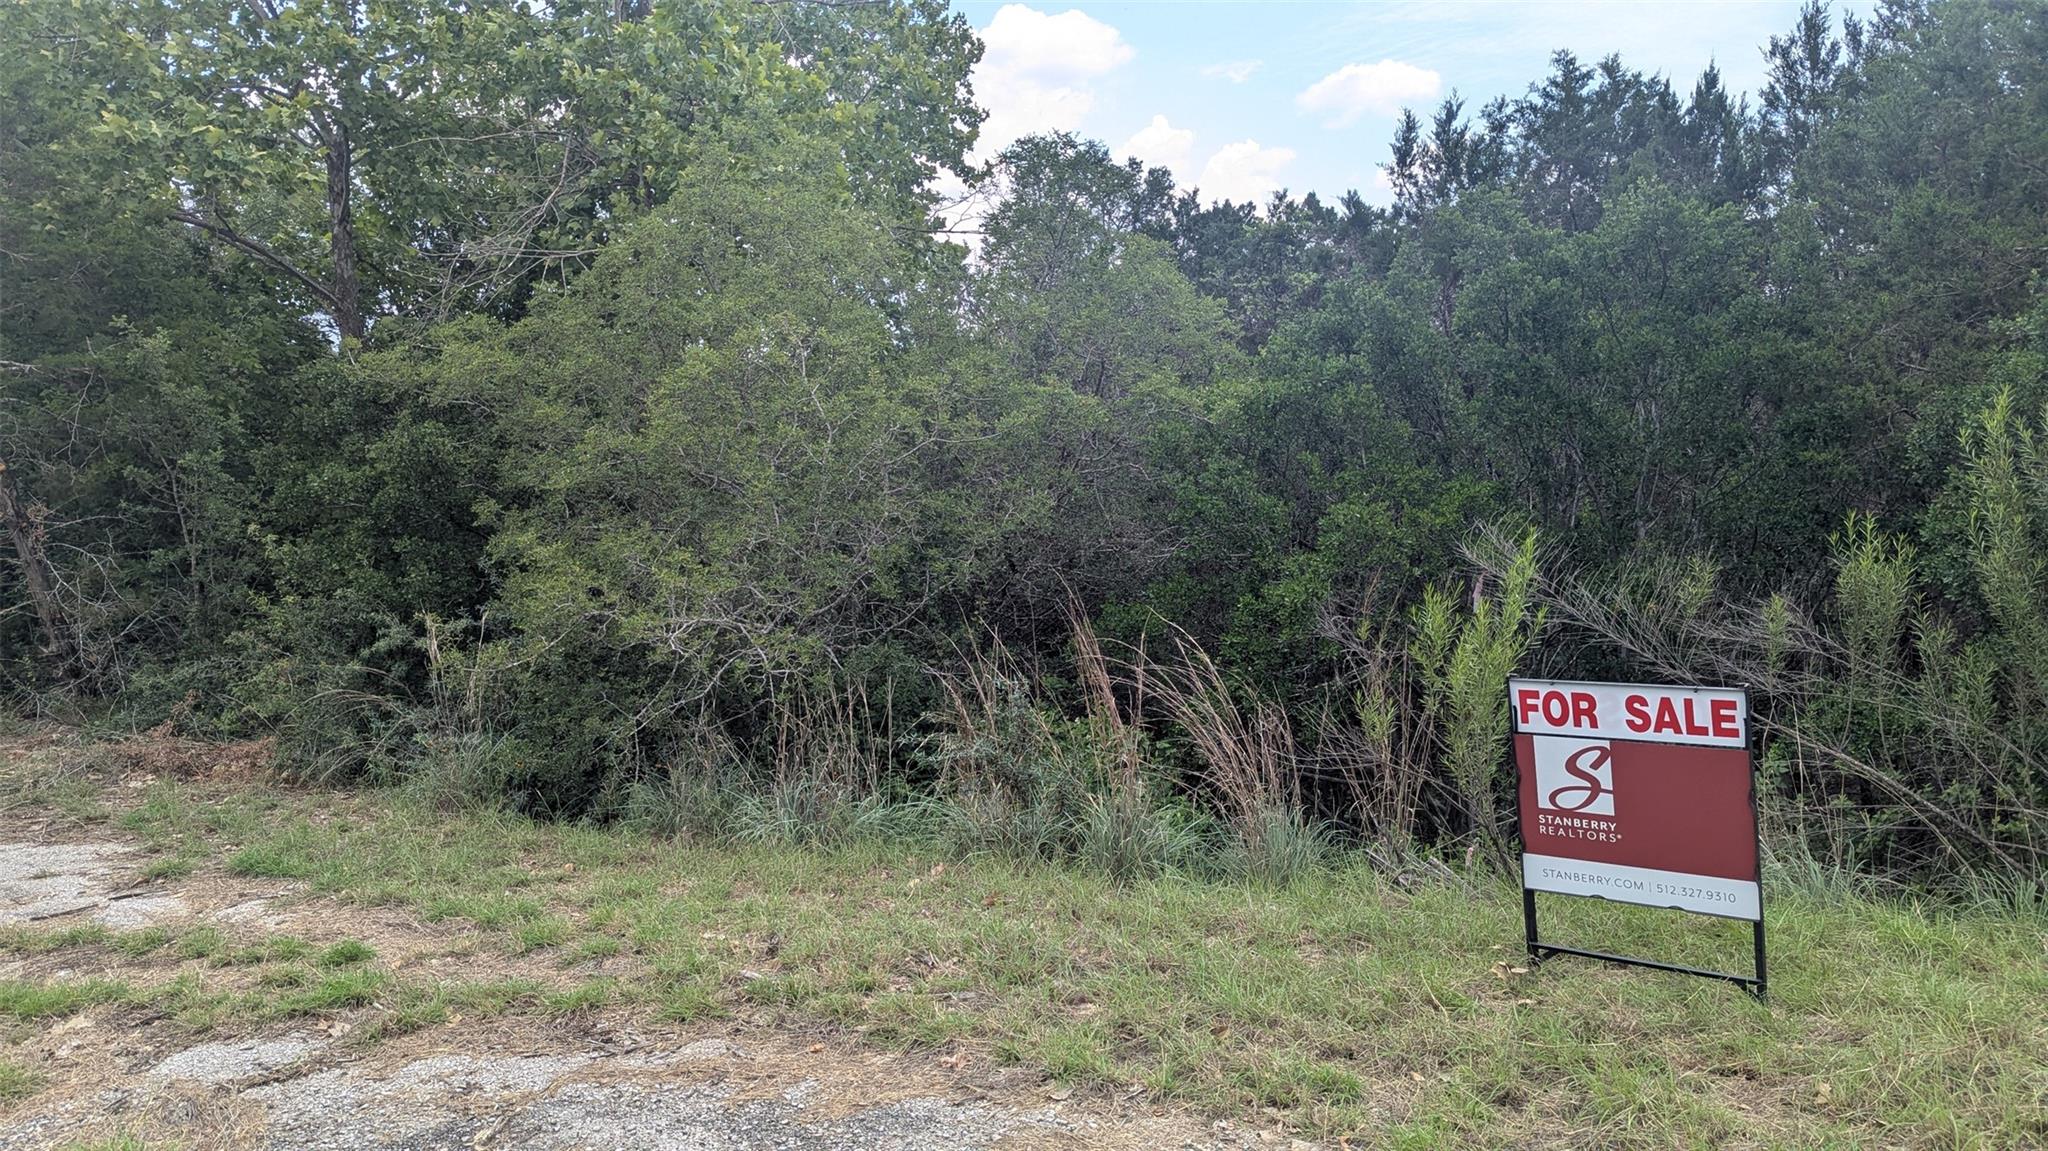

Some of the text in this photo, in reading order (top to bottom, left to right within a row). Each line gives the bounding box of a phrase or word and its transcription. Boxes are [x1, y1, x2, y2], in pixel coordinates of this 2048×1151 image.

[1518, 689, 1740, 738] FOR SALE
[1538, 814, 1617, 831] STANBERRY
[1539, 825, 1622, 843] REALTORS
[1542, 868, 1644, 891] STANBERRY.COM
[1656, 883, 1737, 904] 512.327.9310
